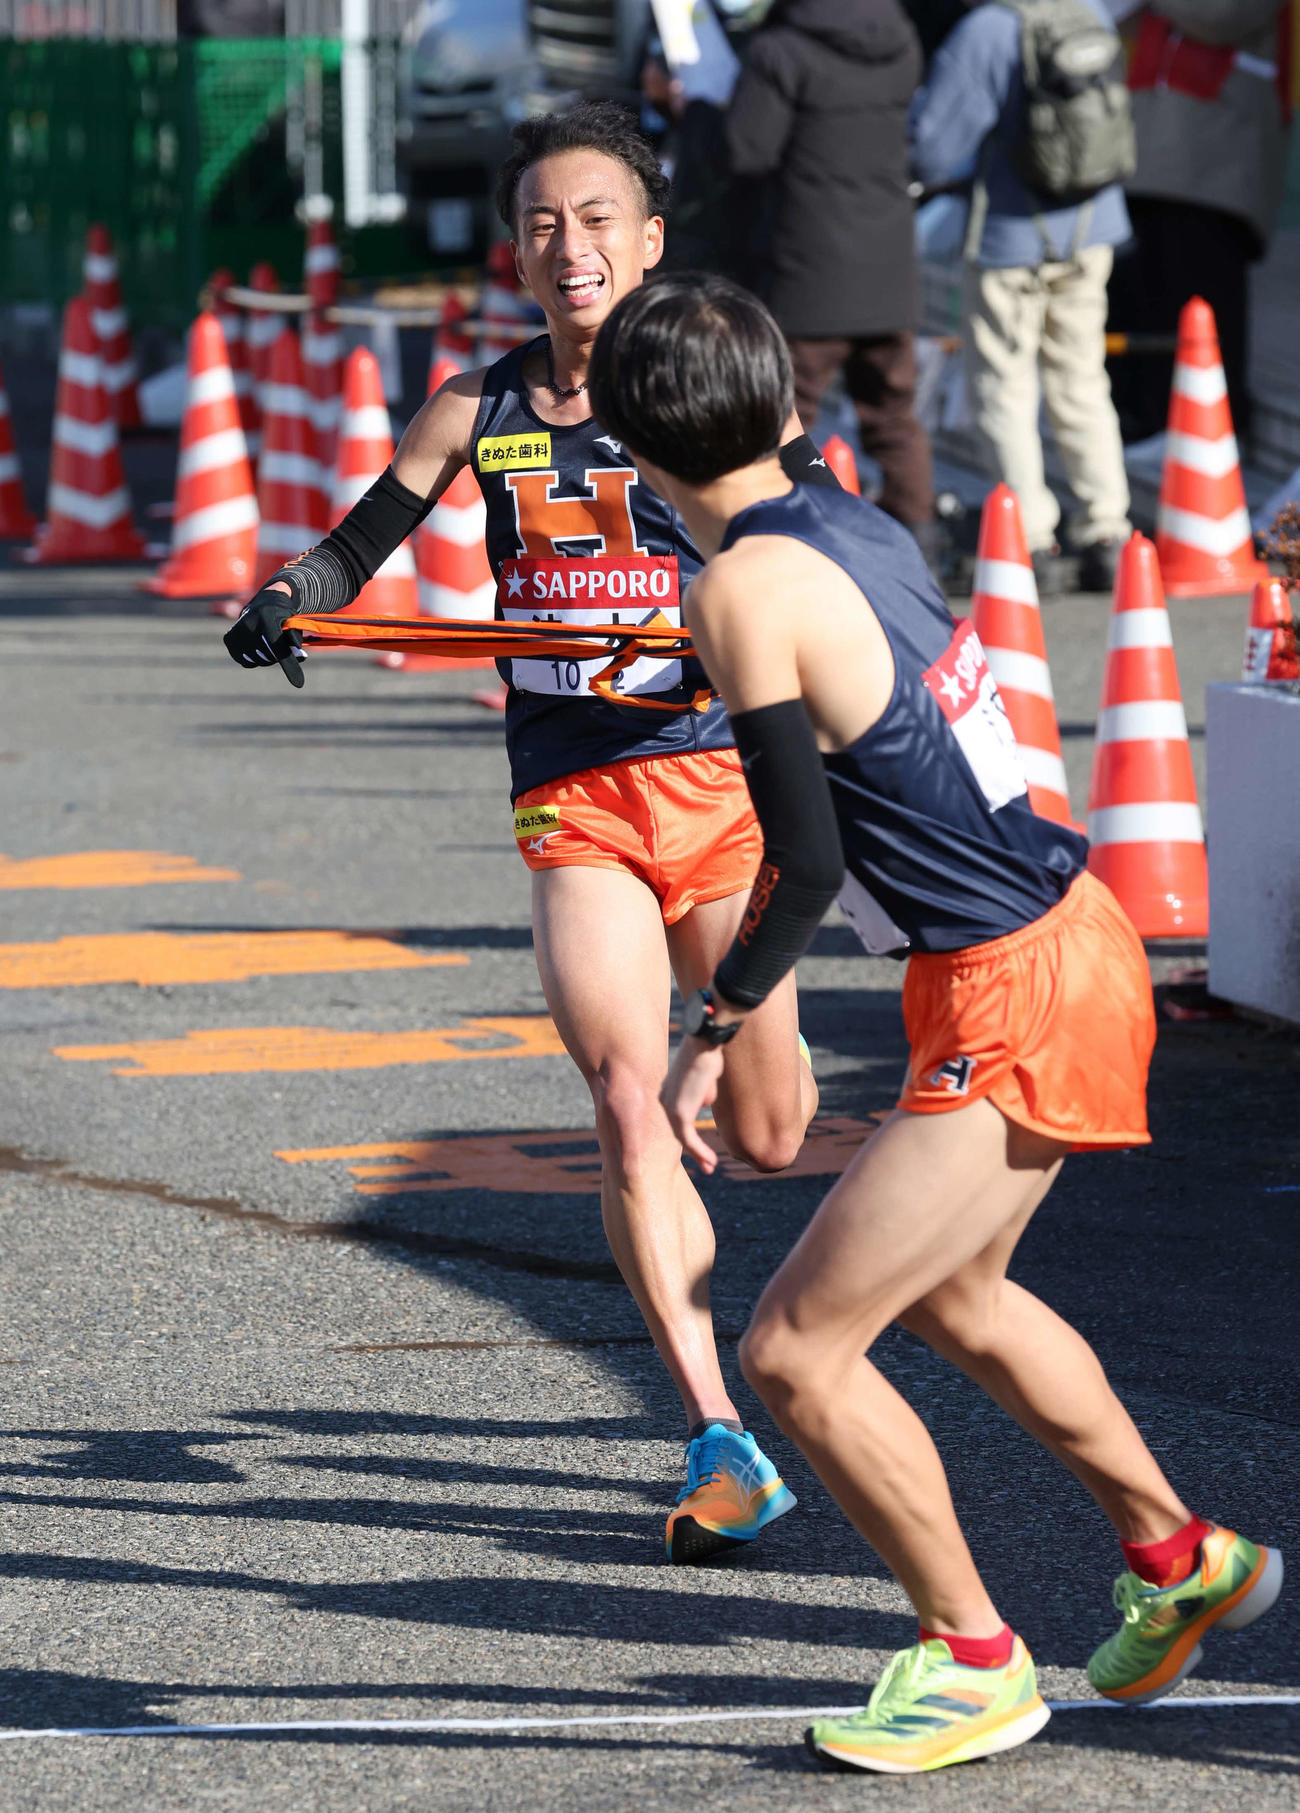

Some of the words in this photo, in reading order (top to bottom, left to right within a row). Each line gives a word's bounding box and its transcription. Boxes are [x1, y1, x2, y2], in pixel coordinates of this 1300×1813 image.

[481, 442, 549, 463] きぬた歯科
[504, 466, 650, 558] H
[533, 568, 670, 599] SAPPORO
